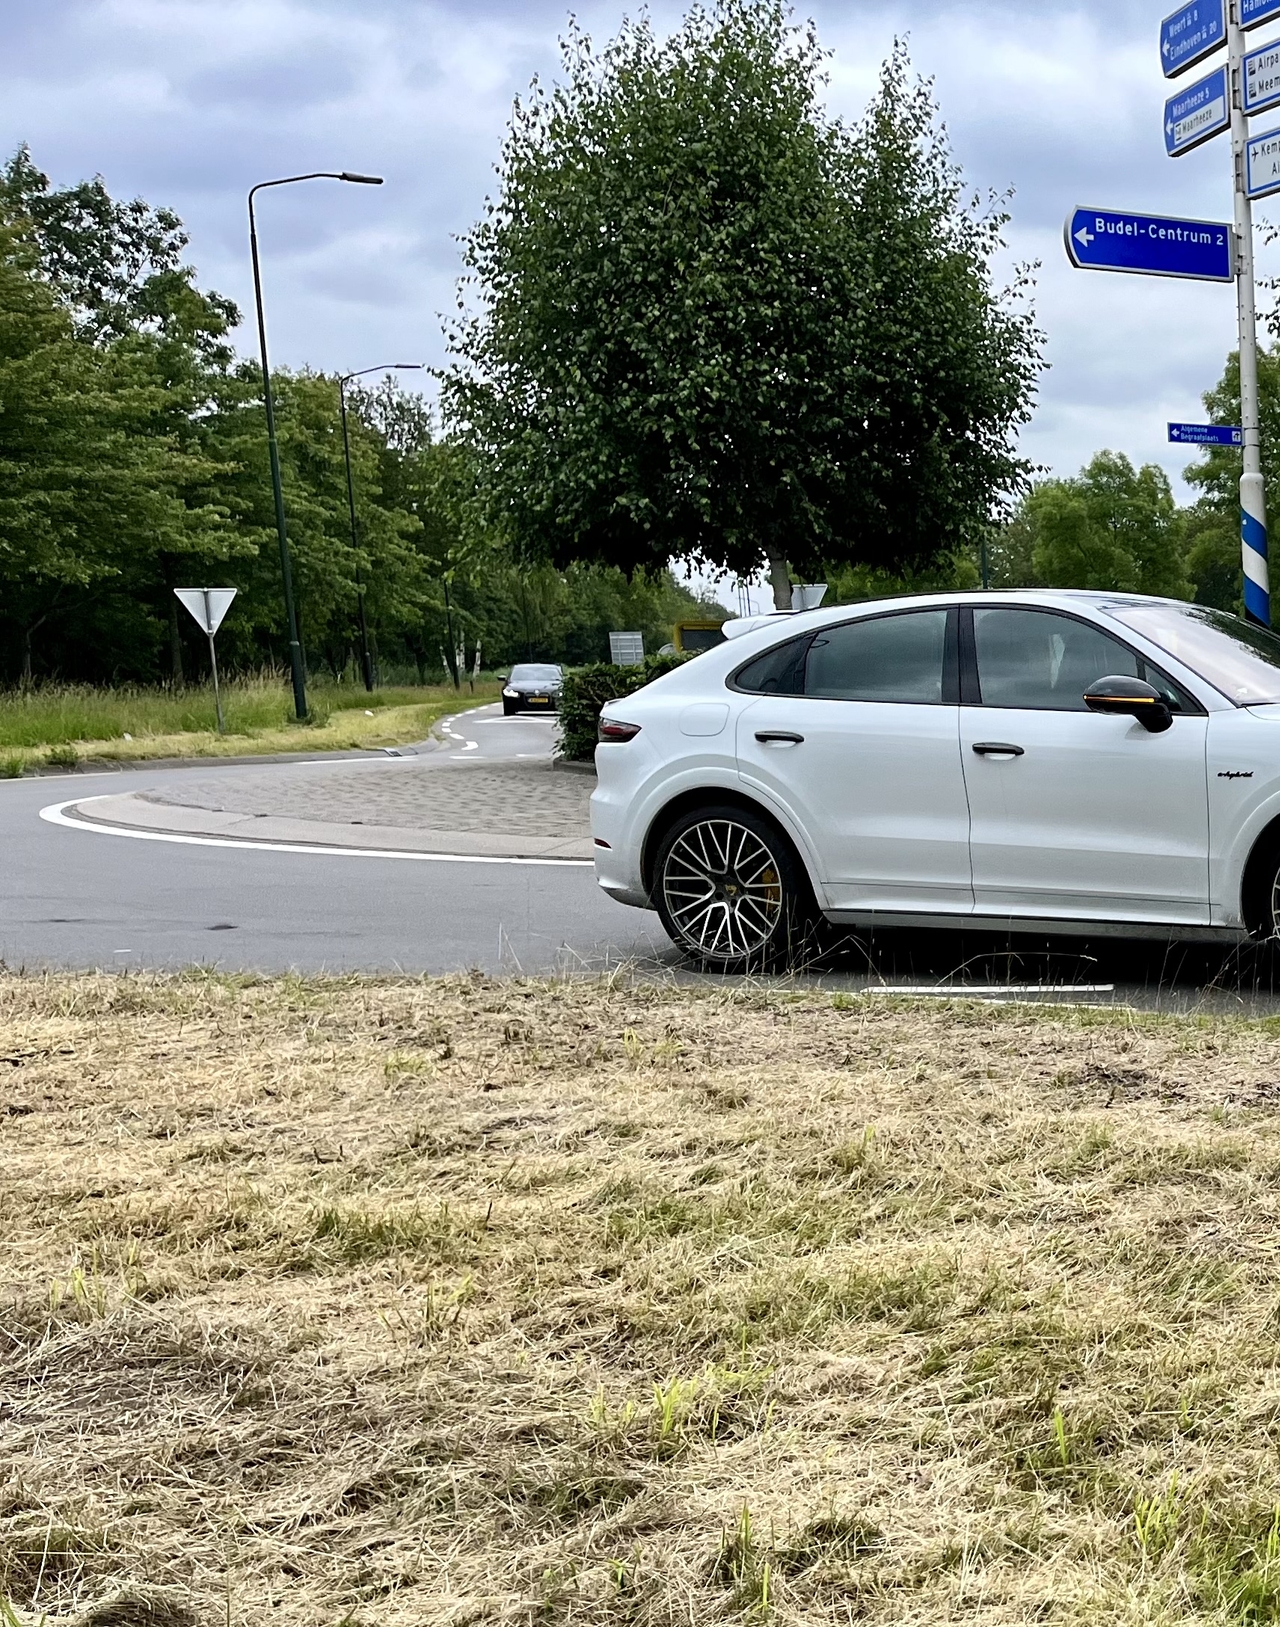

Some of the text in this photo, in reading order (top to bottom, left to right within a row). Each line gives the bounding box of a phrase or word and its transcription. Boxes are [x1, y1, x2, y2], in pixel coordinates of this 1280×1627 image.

[1170, 20, 1217, 61] Eindhoven 20
[1172, 87, 1210, 118] Maarheeze 5
[1182, 108, 1212, 134] Maarheeze
[1095, 217, 1224, 246] Budel-Centrum 2
